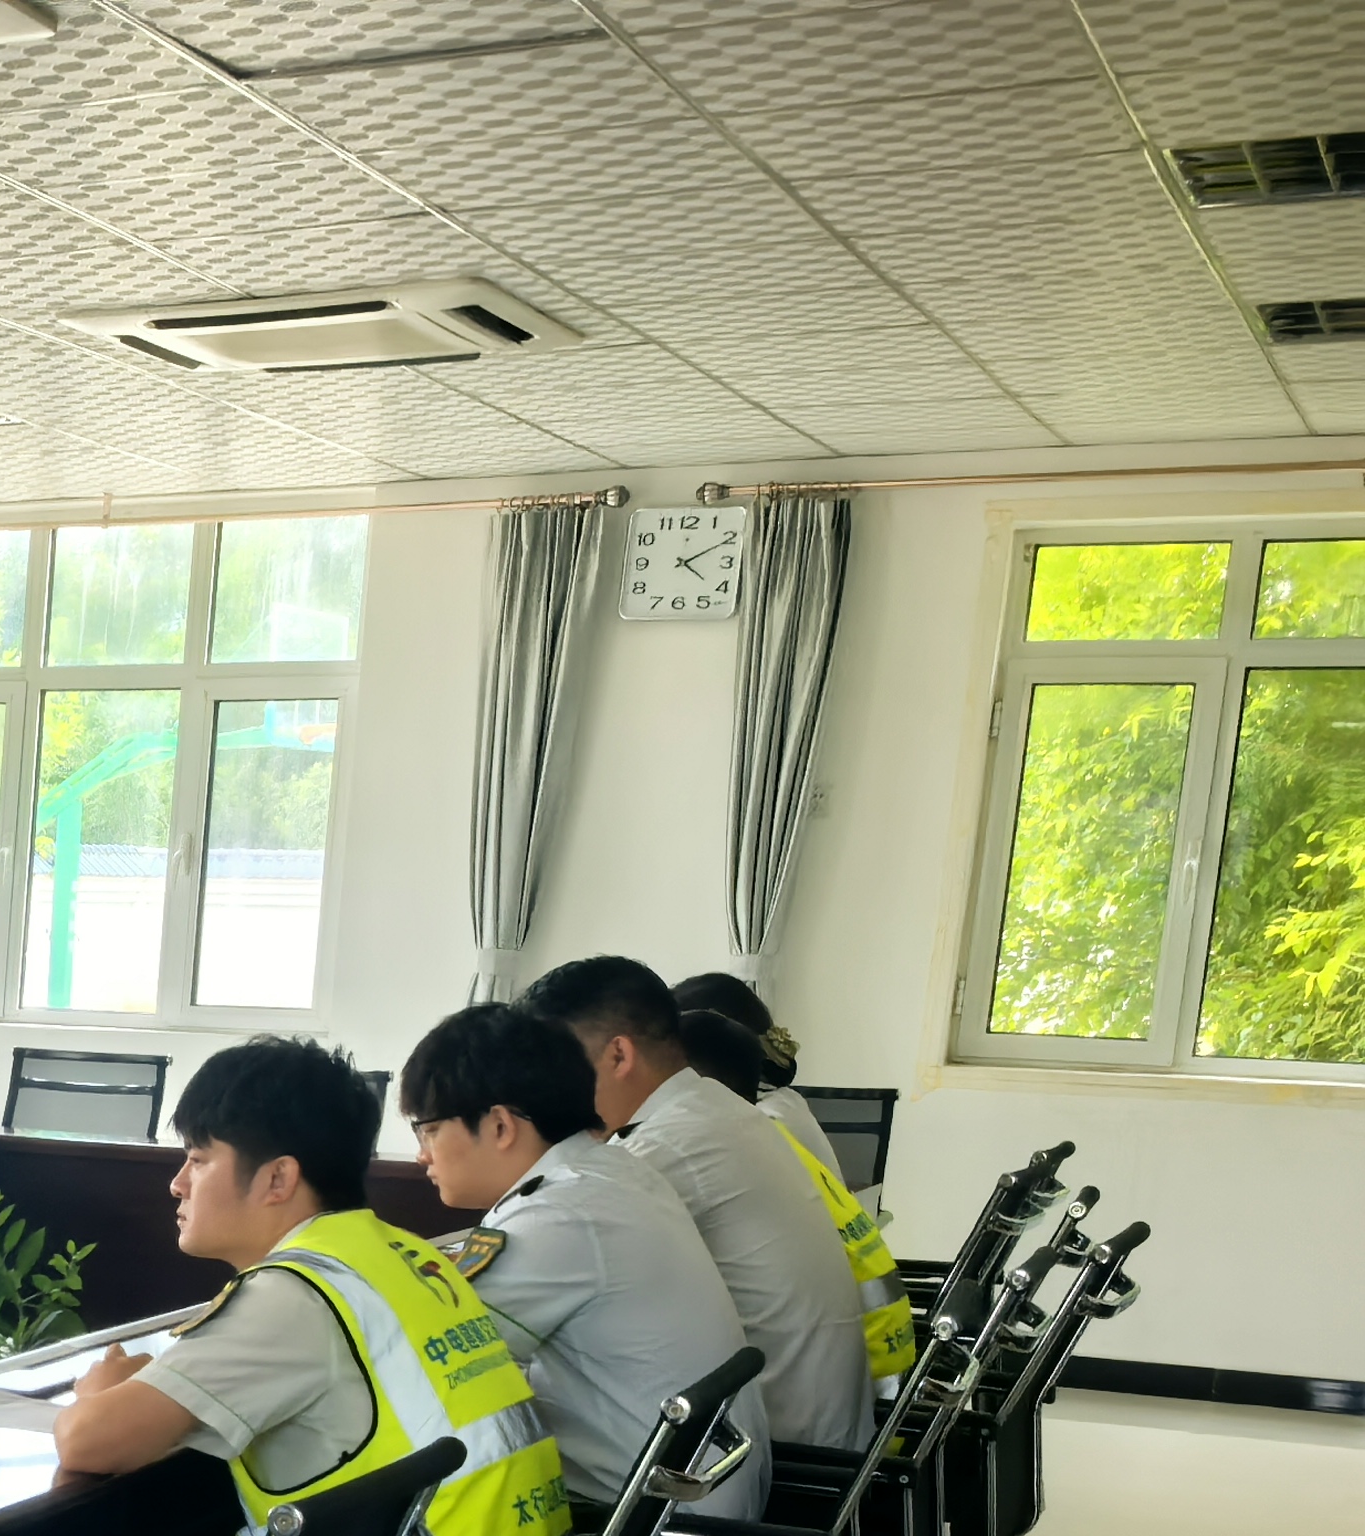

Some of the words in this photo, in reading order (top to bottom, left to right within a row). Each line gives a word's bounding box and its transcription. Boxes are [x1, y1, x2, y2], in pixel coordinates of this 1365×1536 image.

[680, 515, 700, 530] 12
[638, 532, 655, 546] 10
[722, 530, 738, 545] 2
[635, 556, 649, 572] 9
[719, 555, 735, 570] 3
[632, 581, 646, 595] 8
[715, 579, 730, 595] 4
[650, 595, 665, 611] 7
[671, 596, 686, 610] 6
[696, 595, 711, 610] 5
